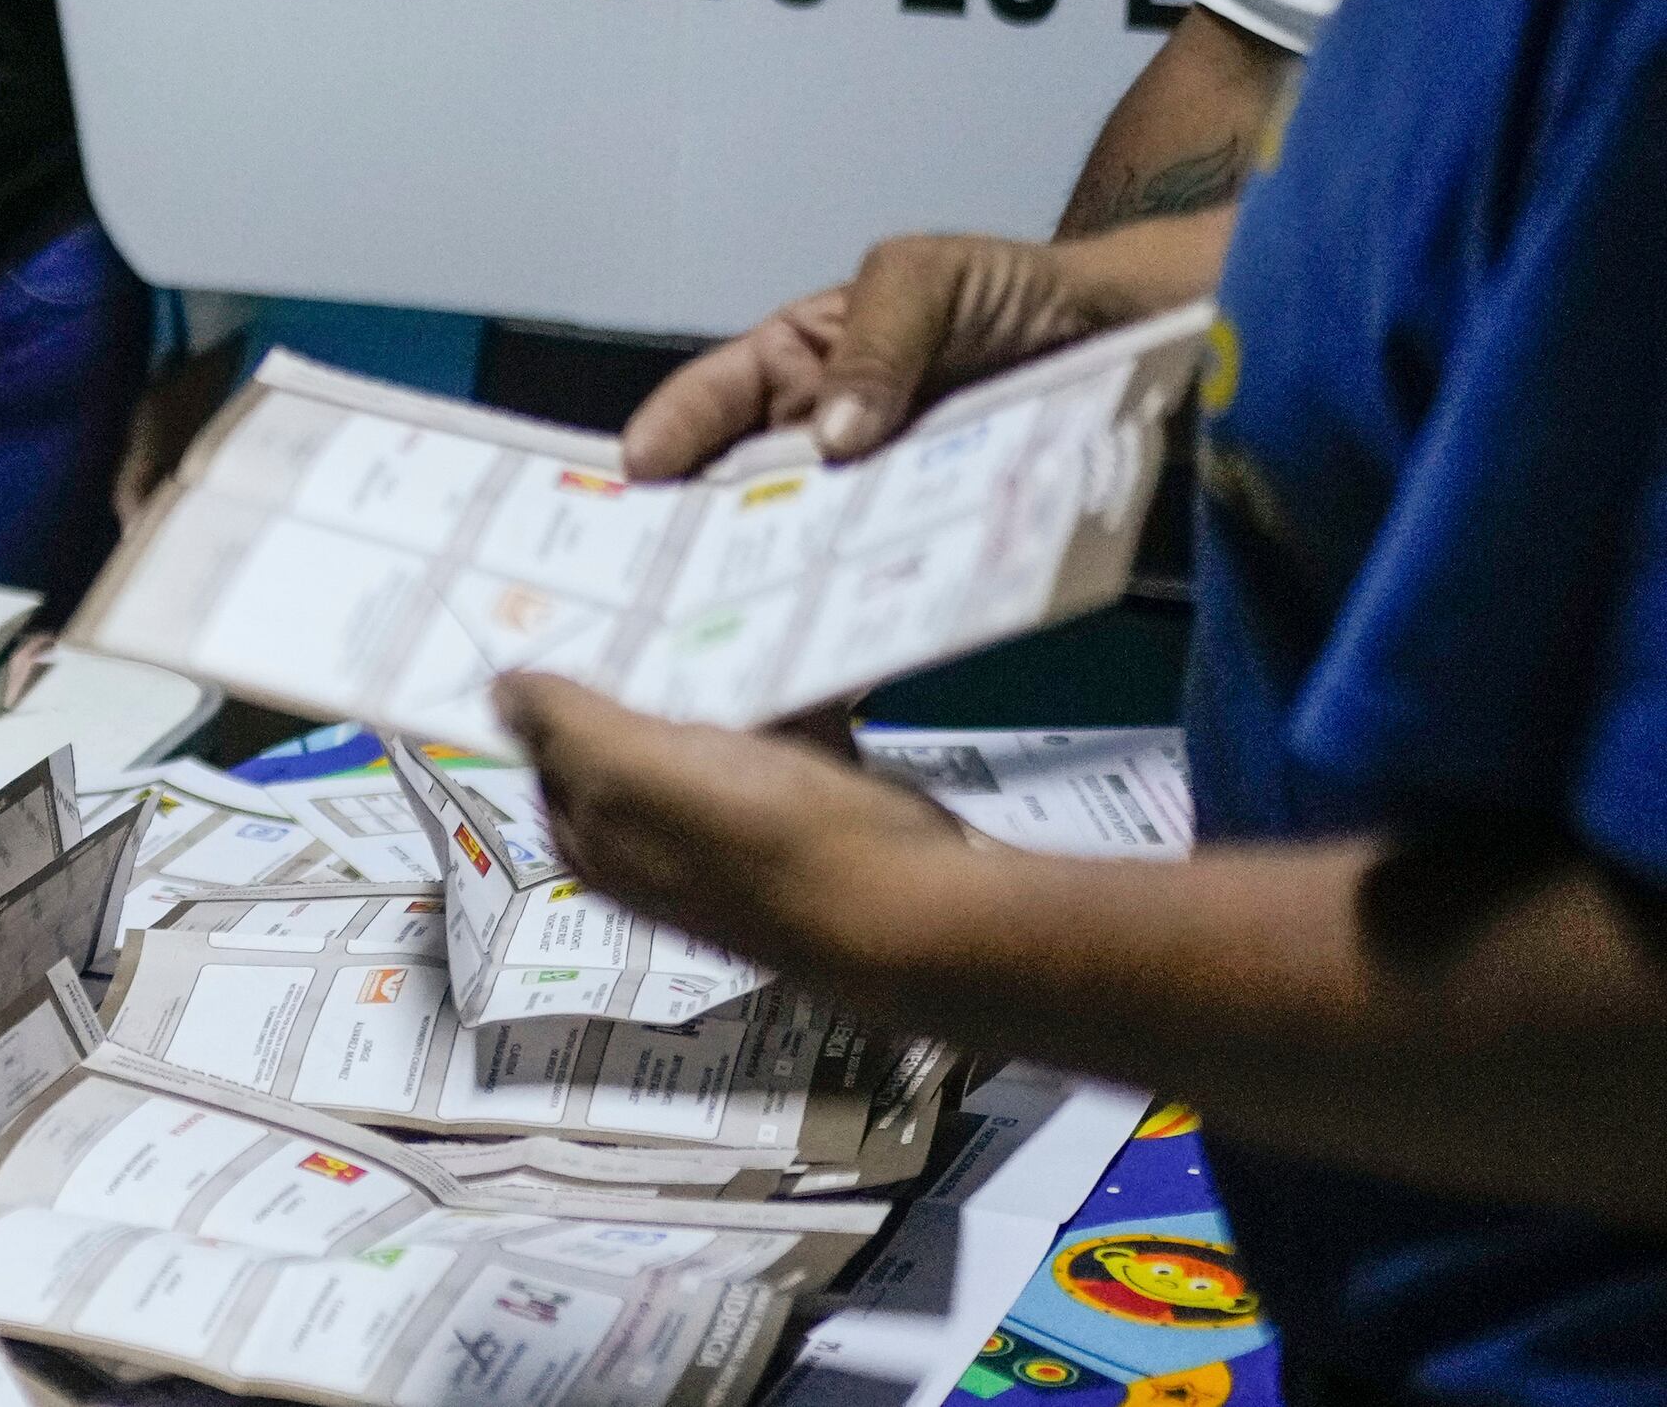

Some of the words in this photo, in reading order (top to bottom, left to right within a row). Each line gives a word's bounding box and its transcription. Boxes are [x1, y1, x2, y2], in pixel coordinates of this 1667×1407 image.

[573, 908, 586, 928] BERTHA
[555, 933, 566, 946] RUIZ
[357, 1037, 373, 1064] JORGE
